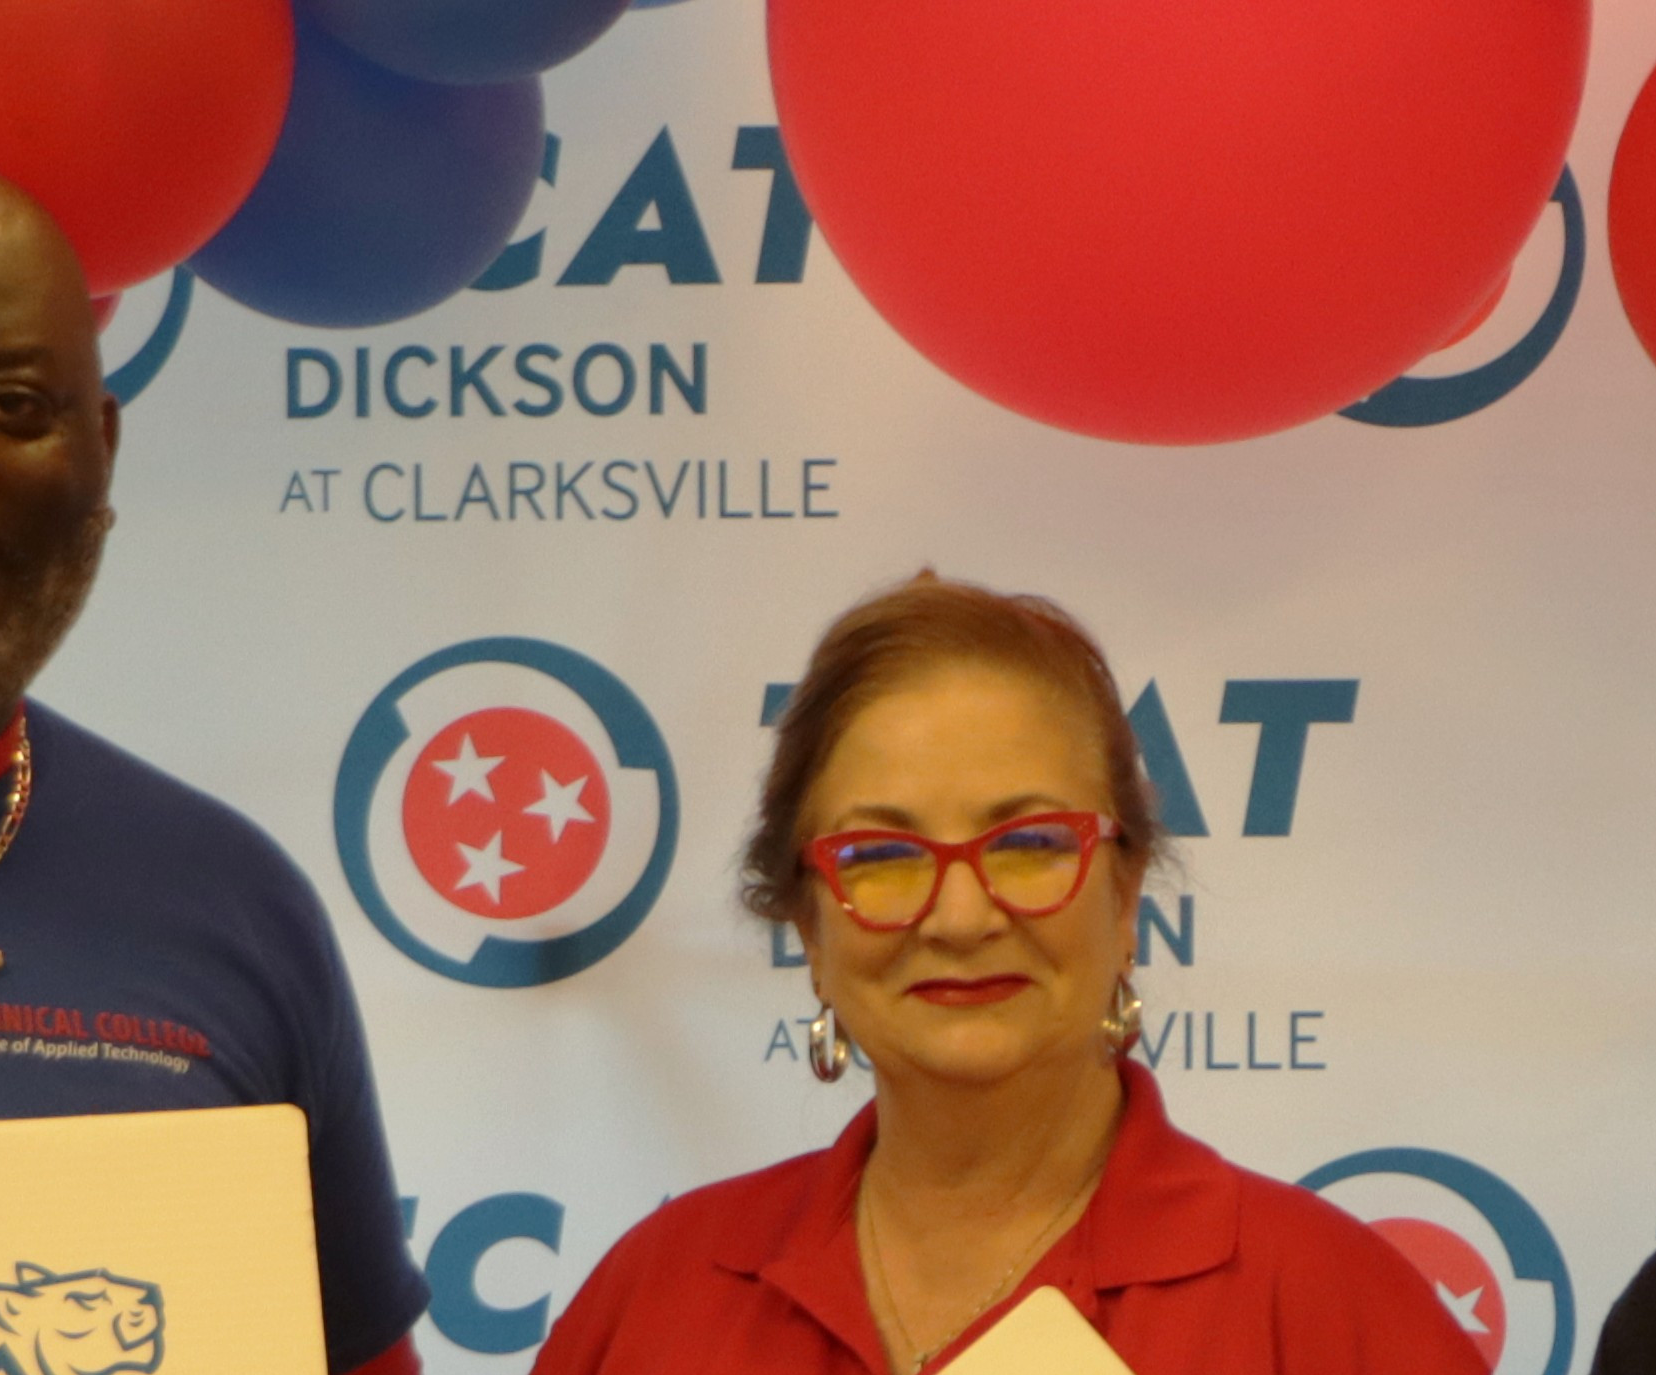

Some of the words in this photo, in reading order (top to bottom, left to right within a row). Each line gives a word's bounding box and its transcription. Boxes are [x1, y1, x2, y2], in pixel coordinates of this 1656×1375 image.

[285, 342, 708, 419] DICKSON
[280, 469, 341, 513] AT
[363, 459, 839, 522] CLARKSVILLE
[12, 1037, 31, 1053] of
[33, 1039, 98, 1061] Applied
[103, 1043, 190, 1074] Technology
[95, 1011, 213, 1057] COLLEGE
